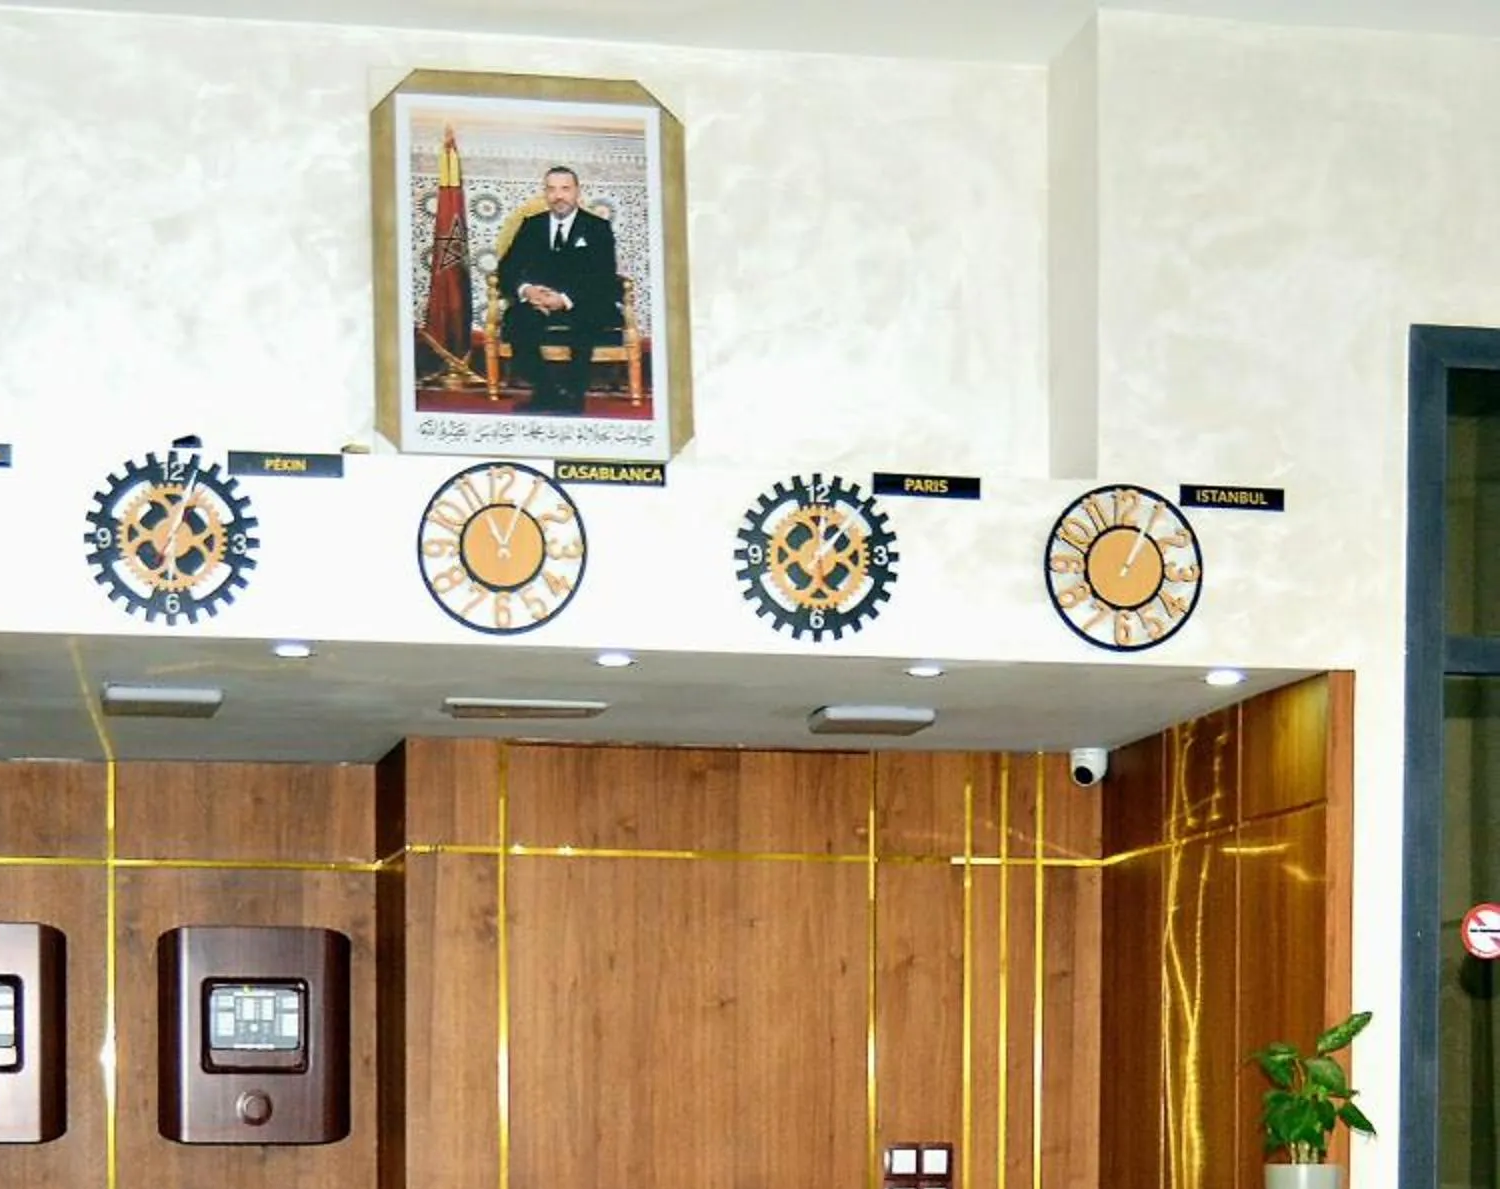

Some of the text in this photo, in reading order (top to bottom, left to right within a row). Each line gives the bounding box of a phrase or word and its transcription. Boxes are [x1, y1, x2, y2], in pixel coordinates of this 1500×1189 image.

[160, 462, 184, 481] 12
[557, 465, 663, 481] CASABLANCA
[456, 475, 484, 511] 11
[487, 467, 515, 503] 12
[521, 477, 542, 510] 1
[806, 484, 830, 503] 12
[903, 477, 949, 493] PARIS
[1195, 489, 1269, 505] ISTANBUL
[427, 500, 467, 534] 10
[537, 503, 573, 524] 2
[96, 527, 112, 548] 9
[231, 533, 247, 554] 3
[423, 539, 460, 557] 9
[546, 539, 583, 559] 3
[748, 544, 763, 564] 9
[873, 546, 889, 565] 3
[433, 566, 466, 593] 8
[543, 571, 572, 596] 4
[165, 593, 181, 614] 6
[461, 584, 489, 616] 7
[495, 592, 510, 628] 6
[520, 585, 549, 620] 5
[809, 610, 825, 629] 6
